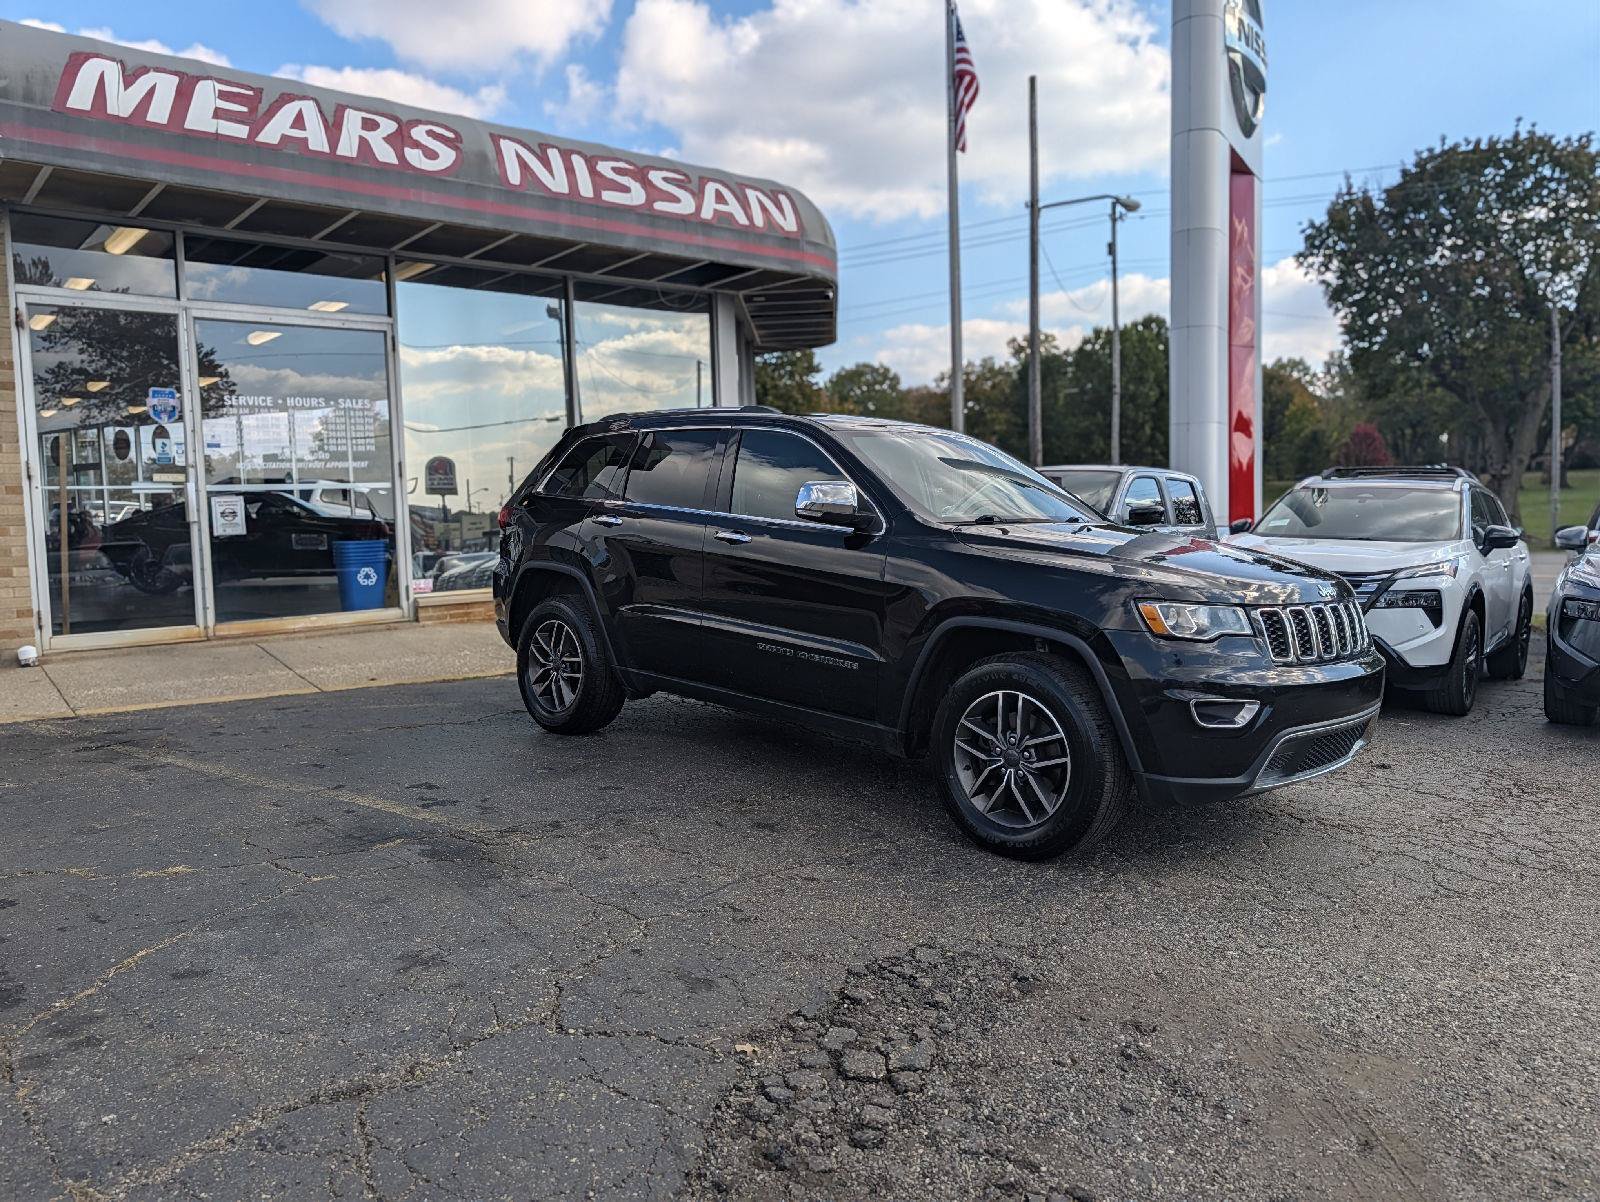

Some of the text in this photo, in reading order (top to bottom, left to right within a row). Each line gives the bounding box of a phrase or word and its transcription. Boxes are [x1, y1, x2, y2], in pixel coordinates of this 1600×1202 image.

[65, 56, 800, 233] MEARS NISSAN
[223, 395, 371, 409] SERVICE HOURS SALES
